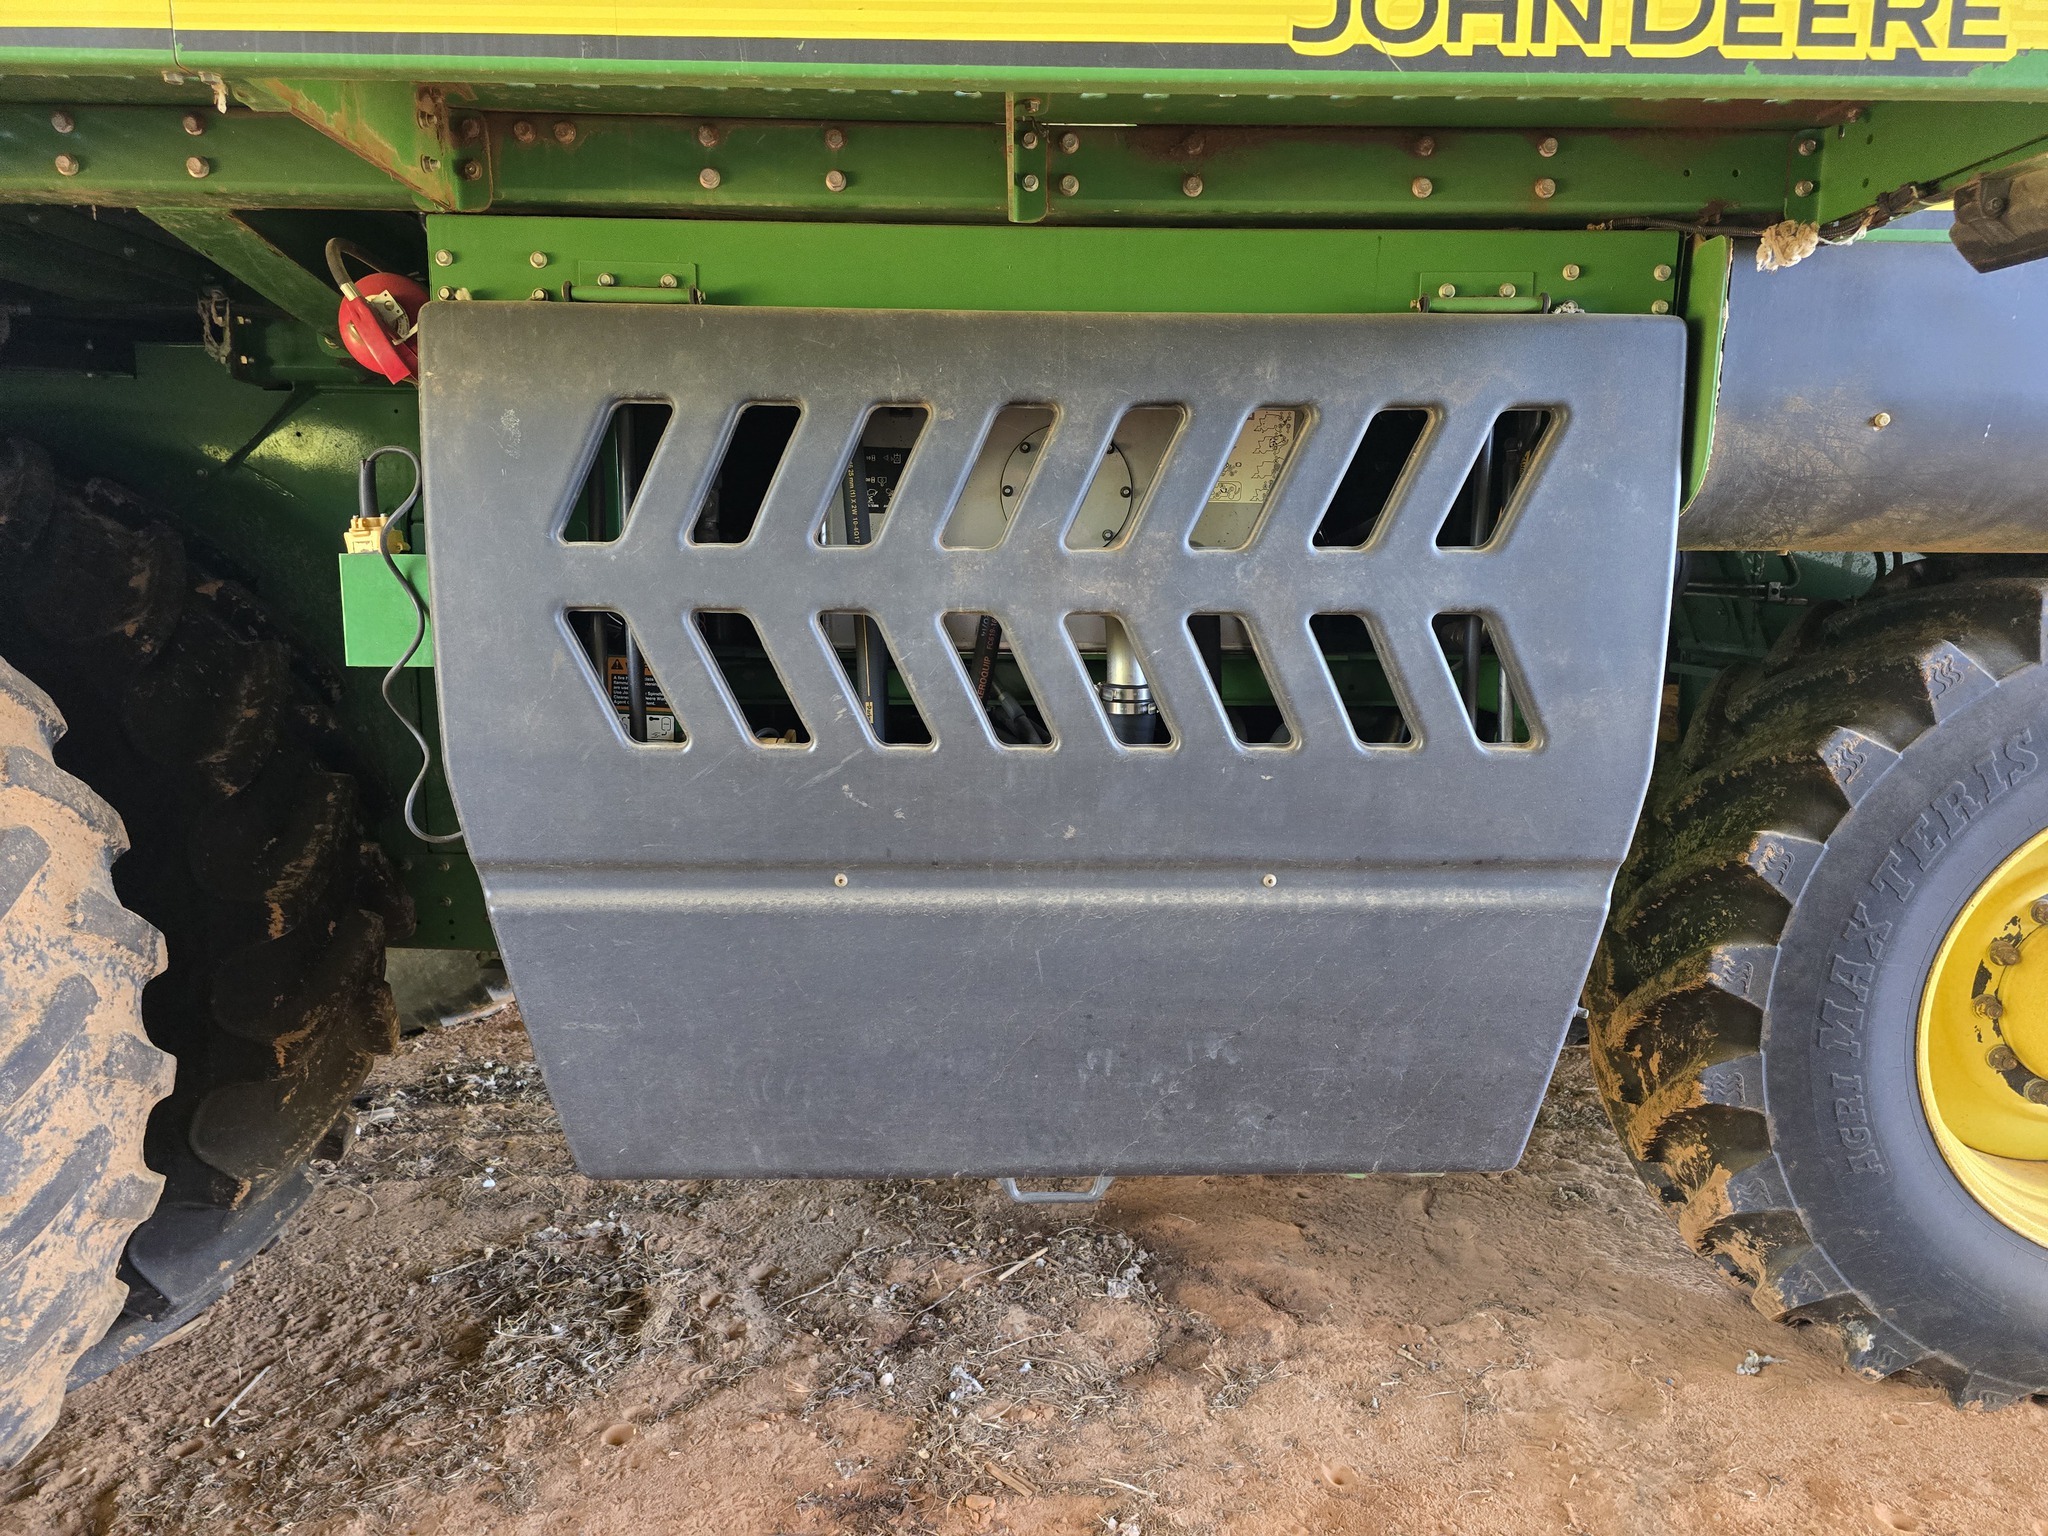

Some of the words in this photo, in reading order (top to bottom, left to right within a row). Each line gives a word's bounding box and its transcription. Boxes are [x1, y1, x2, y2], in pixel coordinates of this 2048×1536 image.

[1290, 0, 1603, 45] JOHN
[1628, 0, 2010, 50] DEERE
[1870, 727, 2040, 903] TERIS
